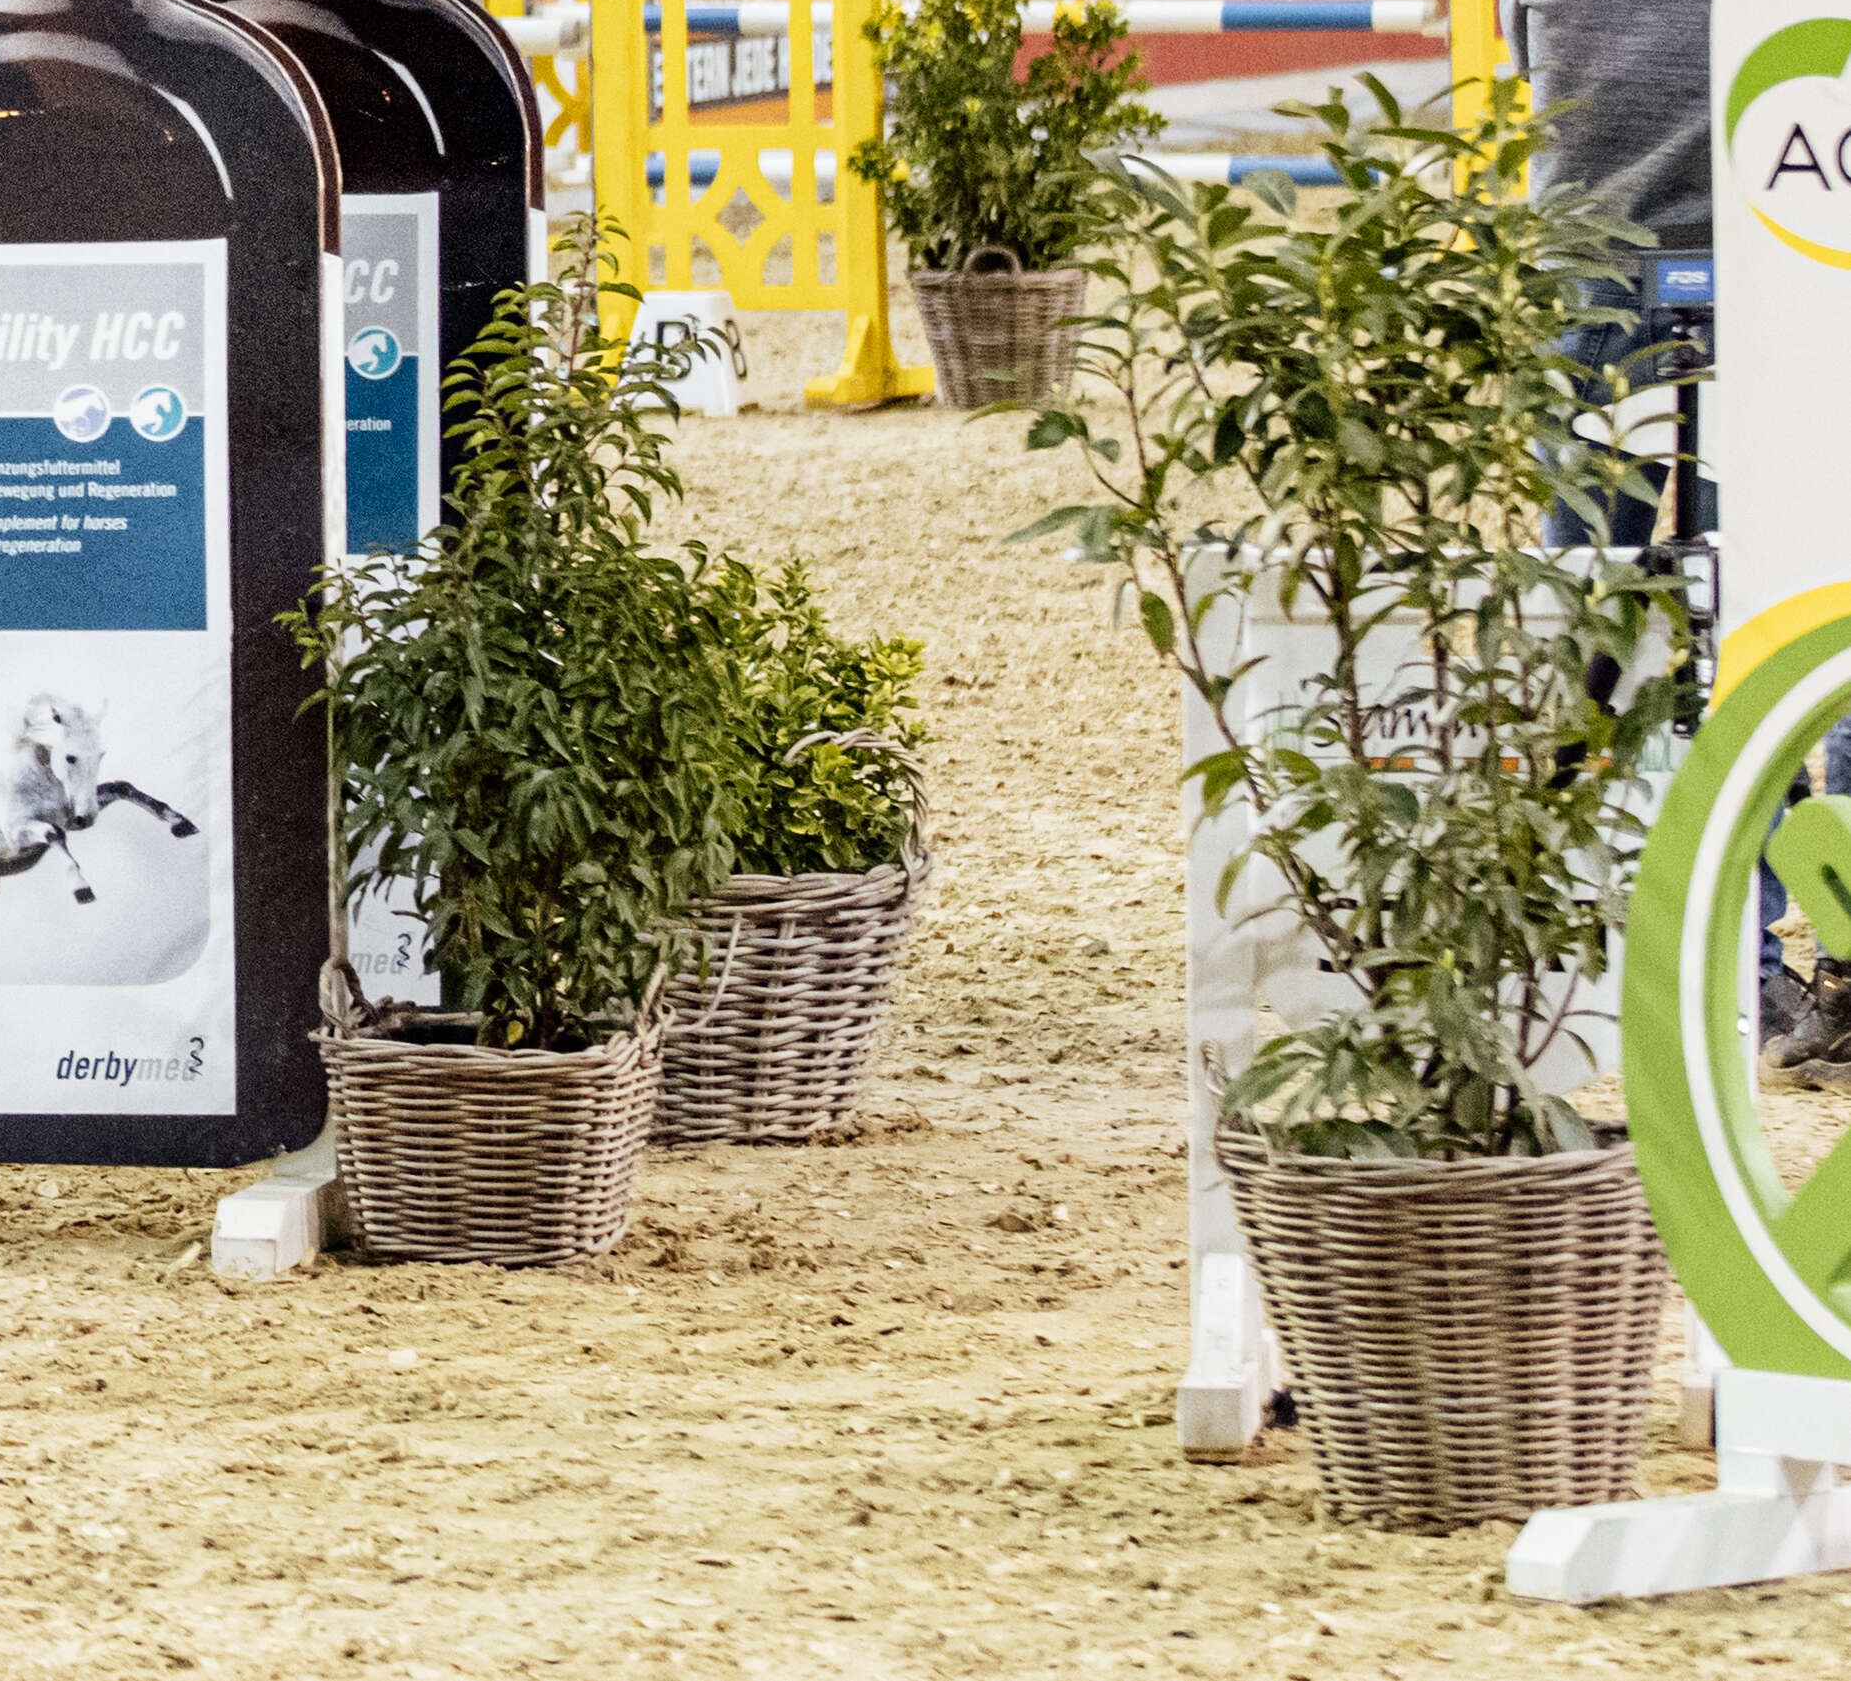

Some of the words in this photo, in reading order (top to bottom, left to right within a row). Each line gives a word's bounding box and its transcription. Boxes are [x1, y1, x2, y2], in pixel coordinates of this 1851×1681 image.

[344, 258, 398, 305] CC
[88, 309, 186, 362] HCC
[58, 482, 84, 498] und
[87, 480, 177, 500] Regeneration
[60, 514, 81, 531] for
[83, 514, 129, 531] horses
